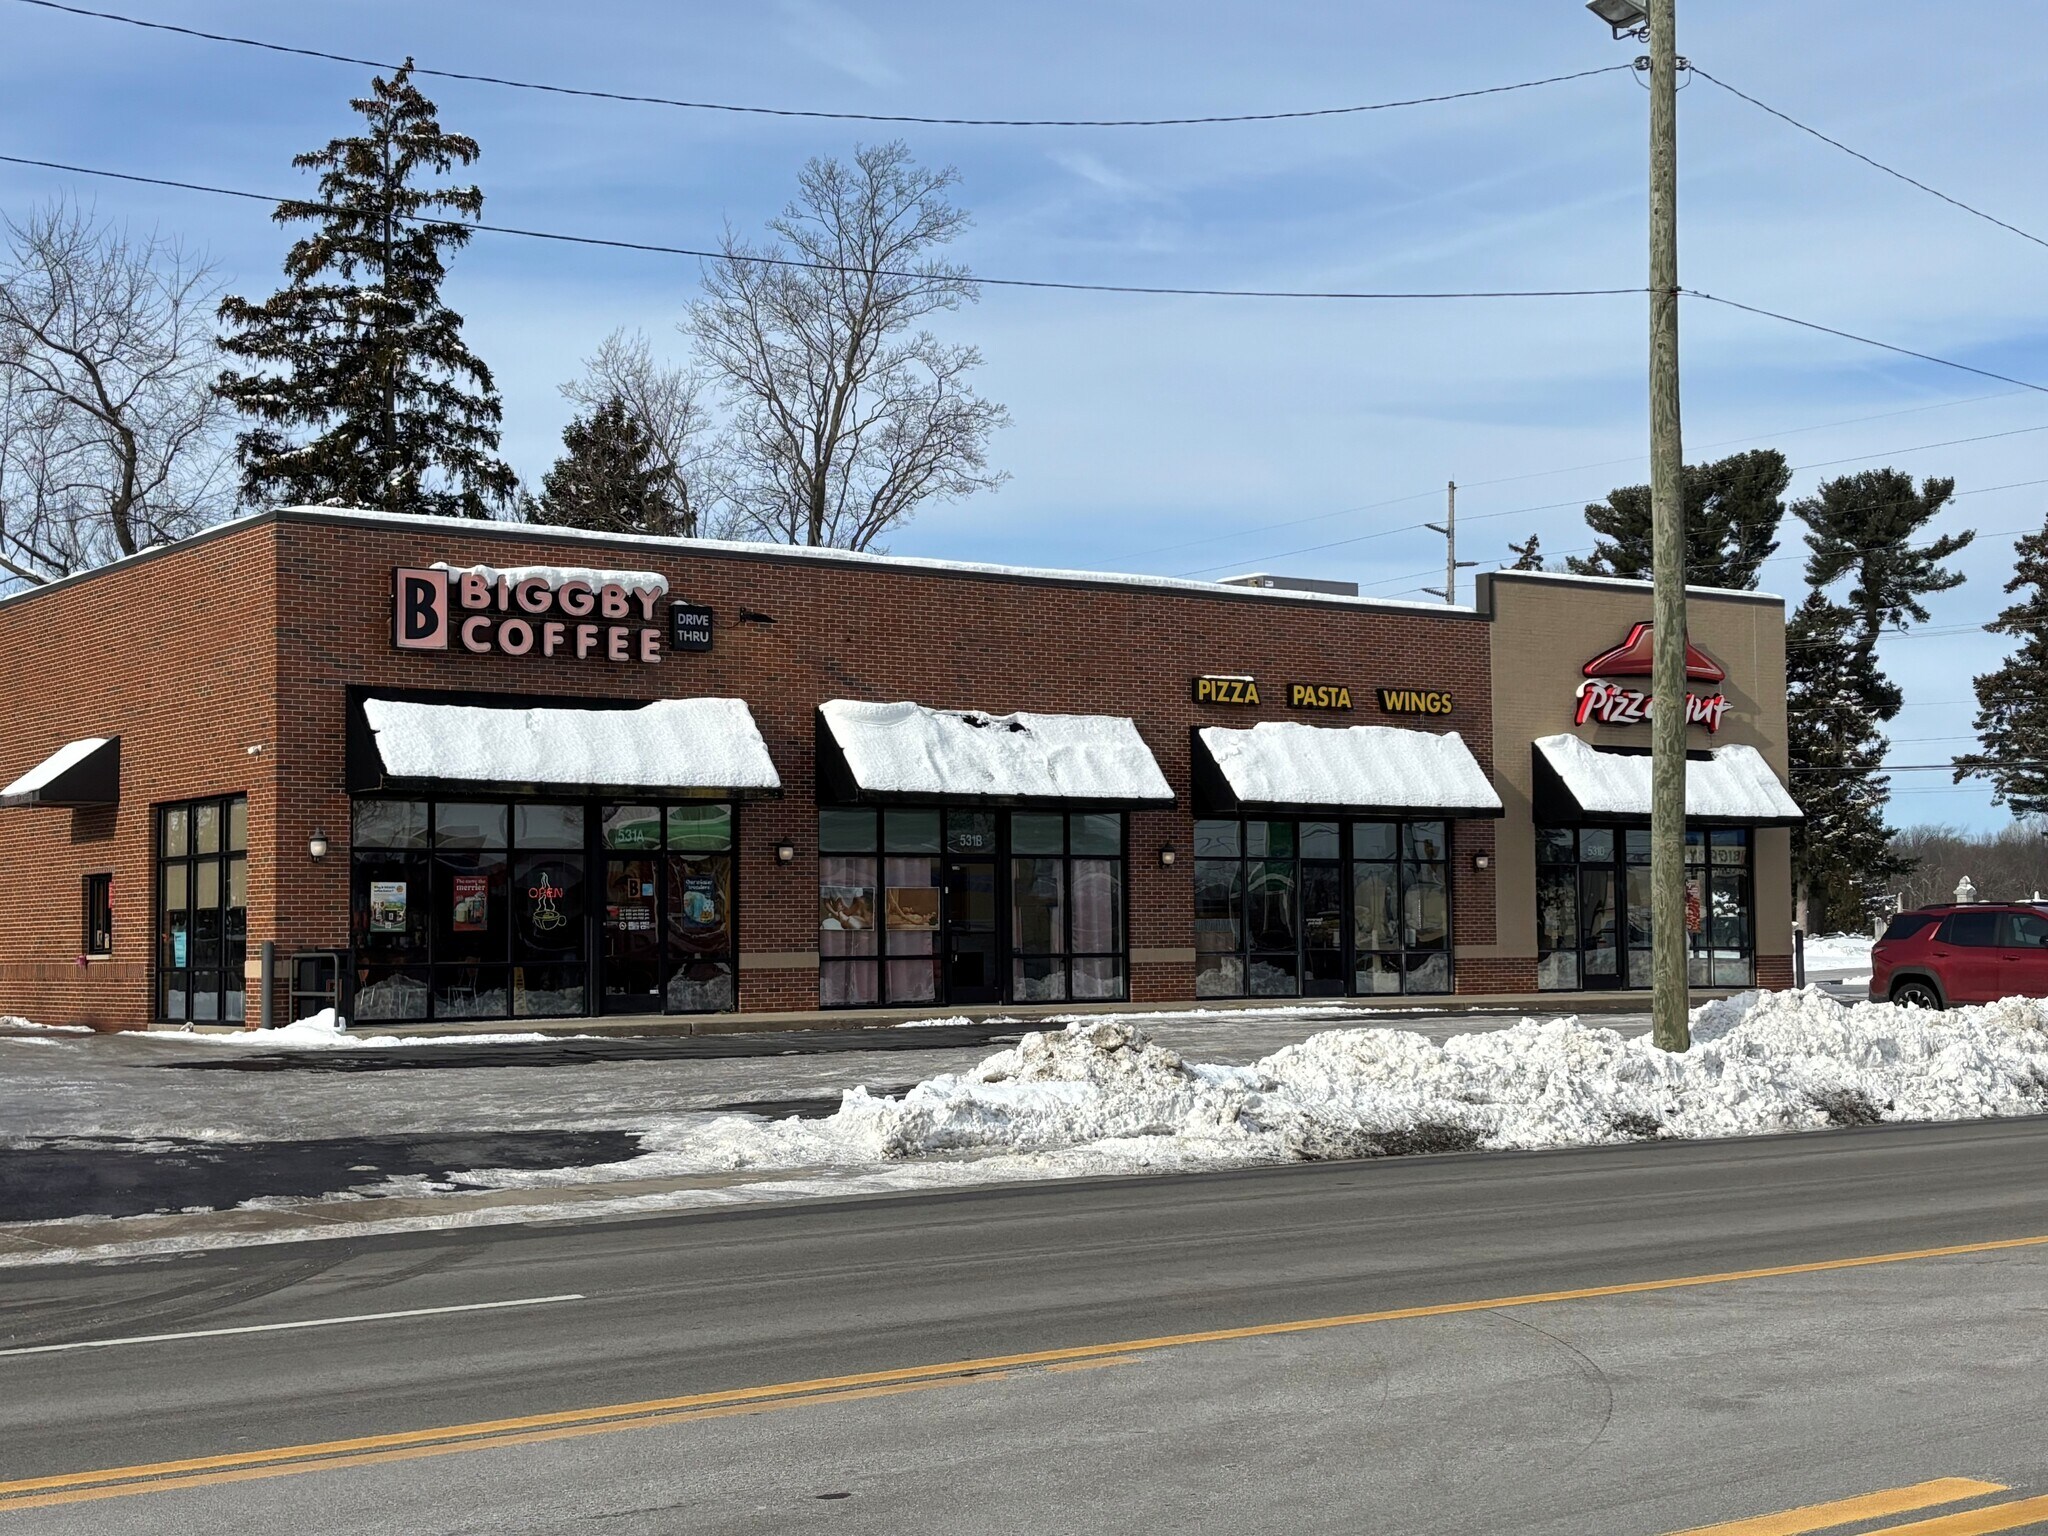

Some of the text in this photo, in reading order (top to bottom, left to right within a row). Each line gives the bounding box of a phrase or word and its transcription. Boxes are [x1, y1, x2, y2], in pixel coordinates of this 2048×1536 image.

[460, 572, 663, 621] BIGGBY
[404, 577, 439, 640] B
[677, 613, 710, 627] DRIVE
[460, 615, 662, 664] COFFEE
[677, 629, 709, 644] THRU
[1198, 680, 1260, 704] PIZZA
[1293, 685, 1352, 708] PASTA
[1383, 690, 1453, 714] WINGS
[618, 829, 645, 842] 531A
[959, 834, 983, 847] 531B
[456, 883, 486, 891] merrier
[528, 887, 564, 899] OPEN
